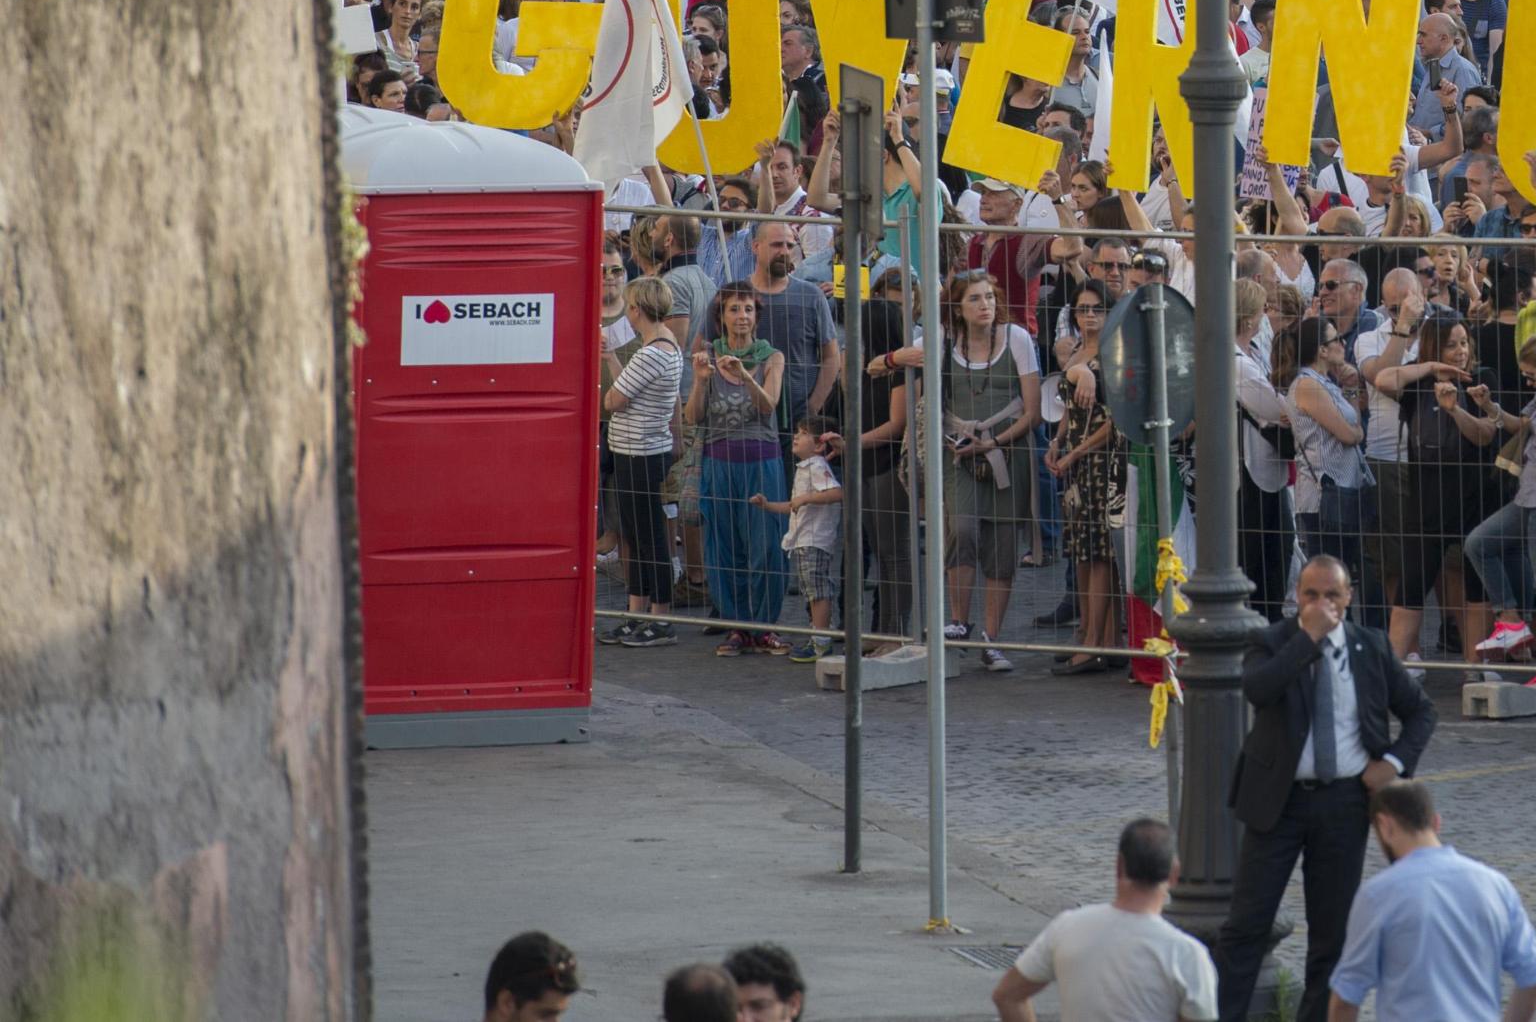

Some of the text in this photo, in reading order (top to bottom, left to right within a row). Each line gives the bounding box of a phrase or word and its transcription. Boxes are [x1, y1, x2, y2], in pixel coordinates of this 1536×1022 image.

[415, 301, 541, 320] I SEBACH
[489, 319, 541, 327] WWW.SEBACH.COM
